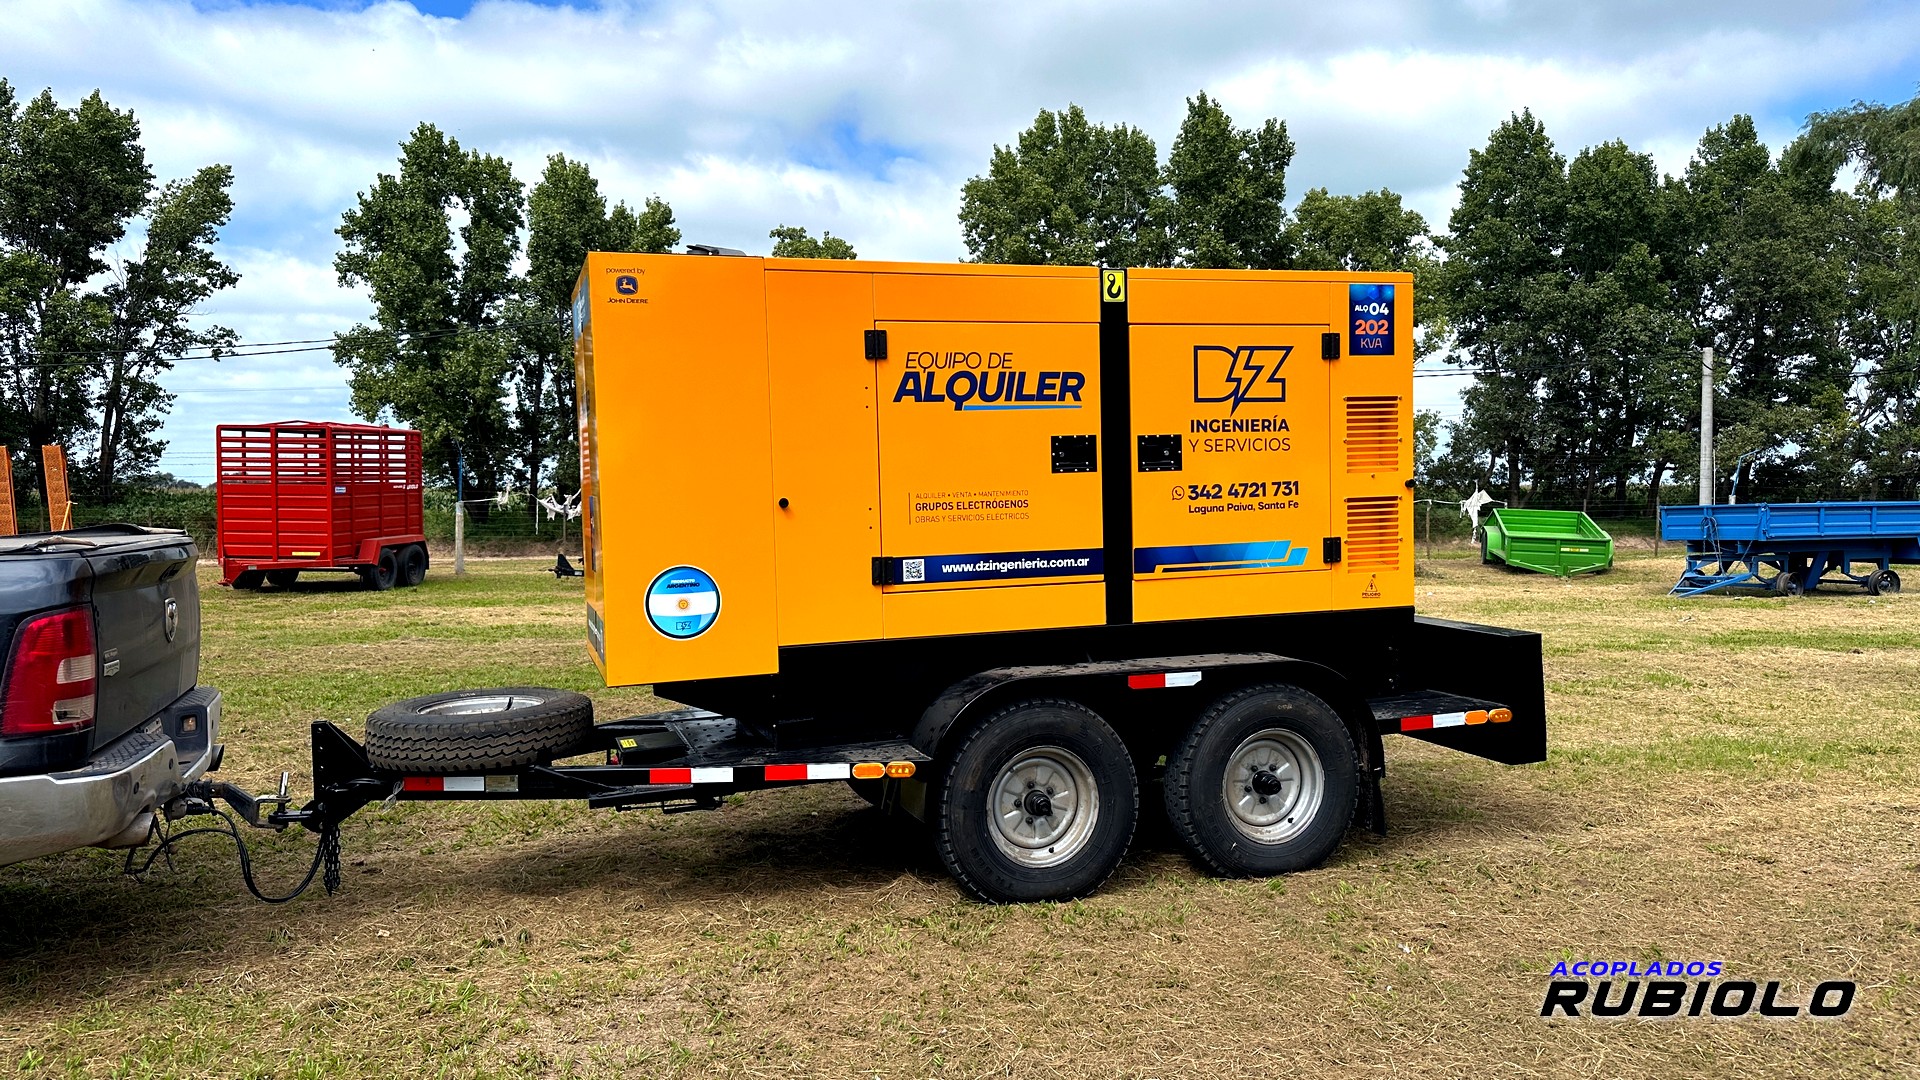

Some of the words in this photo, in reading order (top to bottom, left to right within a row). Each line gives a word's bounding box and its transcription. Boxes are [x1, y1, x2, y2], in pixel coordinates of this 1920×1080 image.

[1369, 302, 1389, 316] 04
[1355, 319, 1389, 335] 202
[1360, 338, 1382, 348] KVA
[905, 352, 982, 373] EQUIPO
[987, 352, 1013, 369] DE
[893, 371, 1086, 411] ALQUILER
[1190, 415, 1290, 433] INGENIERÍA
[1188, 439, 1199, 452] Y
[1204, 438, 1291, 452] SERVICIOS
[1188, 483, 1223, 500] 342
[1228, 482, 1267, 498] 4721
[1271, 480, 1299, 497] 731
[915, 502, 954, 511] GRUPOS
[956, 498, 1029, 510] ELECTRÓGENOS
[1188, 504, 1224, 515] Laguna
[1227, 502, 1256, 512] Paiva,
[1258, 501, 1286, 510] Santa
[1288, 500, 1299, 509] Fe
[915, 515, 940, 523] OBRAS
[947, 514, 984, 522] SERVICIOS
[941, 557, 1090, 573] www.dzingenieria.com.ar
